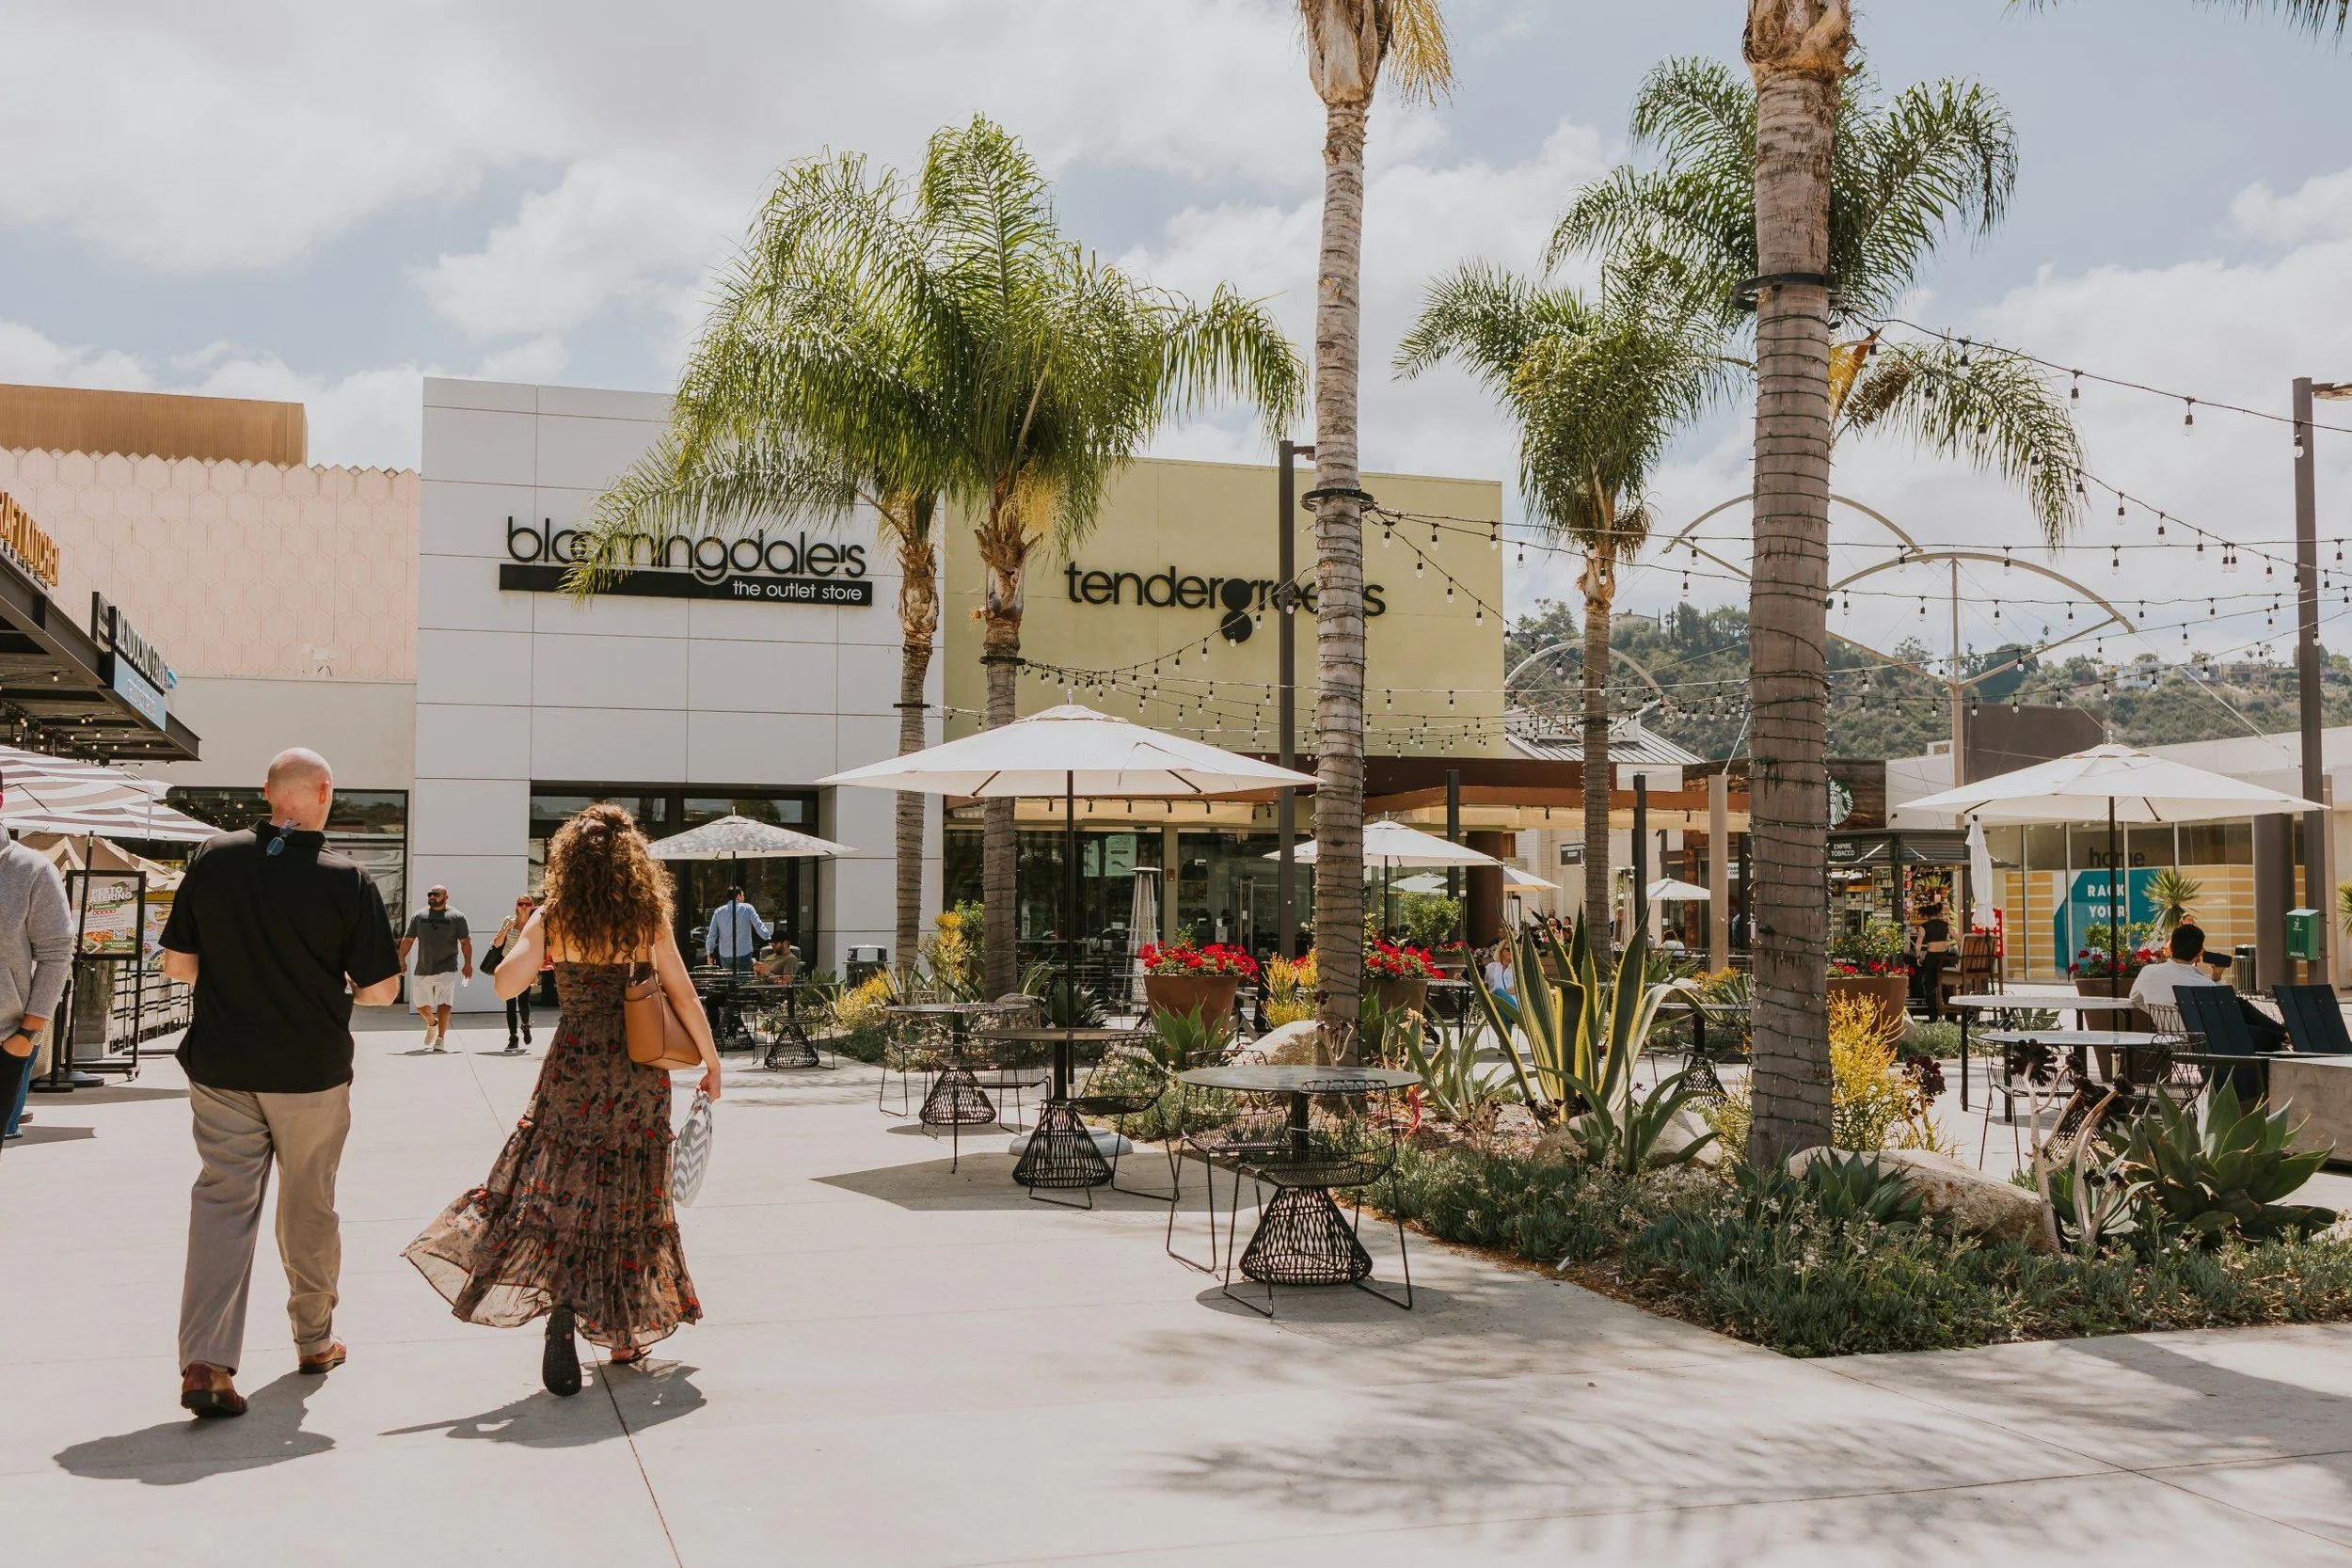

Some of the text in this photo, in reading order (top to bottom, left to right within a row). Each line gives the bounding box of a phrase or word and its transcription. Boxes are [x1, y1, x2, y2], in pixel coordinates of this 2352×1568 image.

[508, 516, 866, 582] bloomingdale's
[733, 580, 863, 600] the outlet store
[87, 892, 132, 904] ATERING
[92, 886, 122, 898] PESTO
